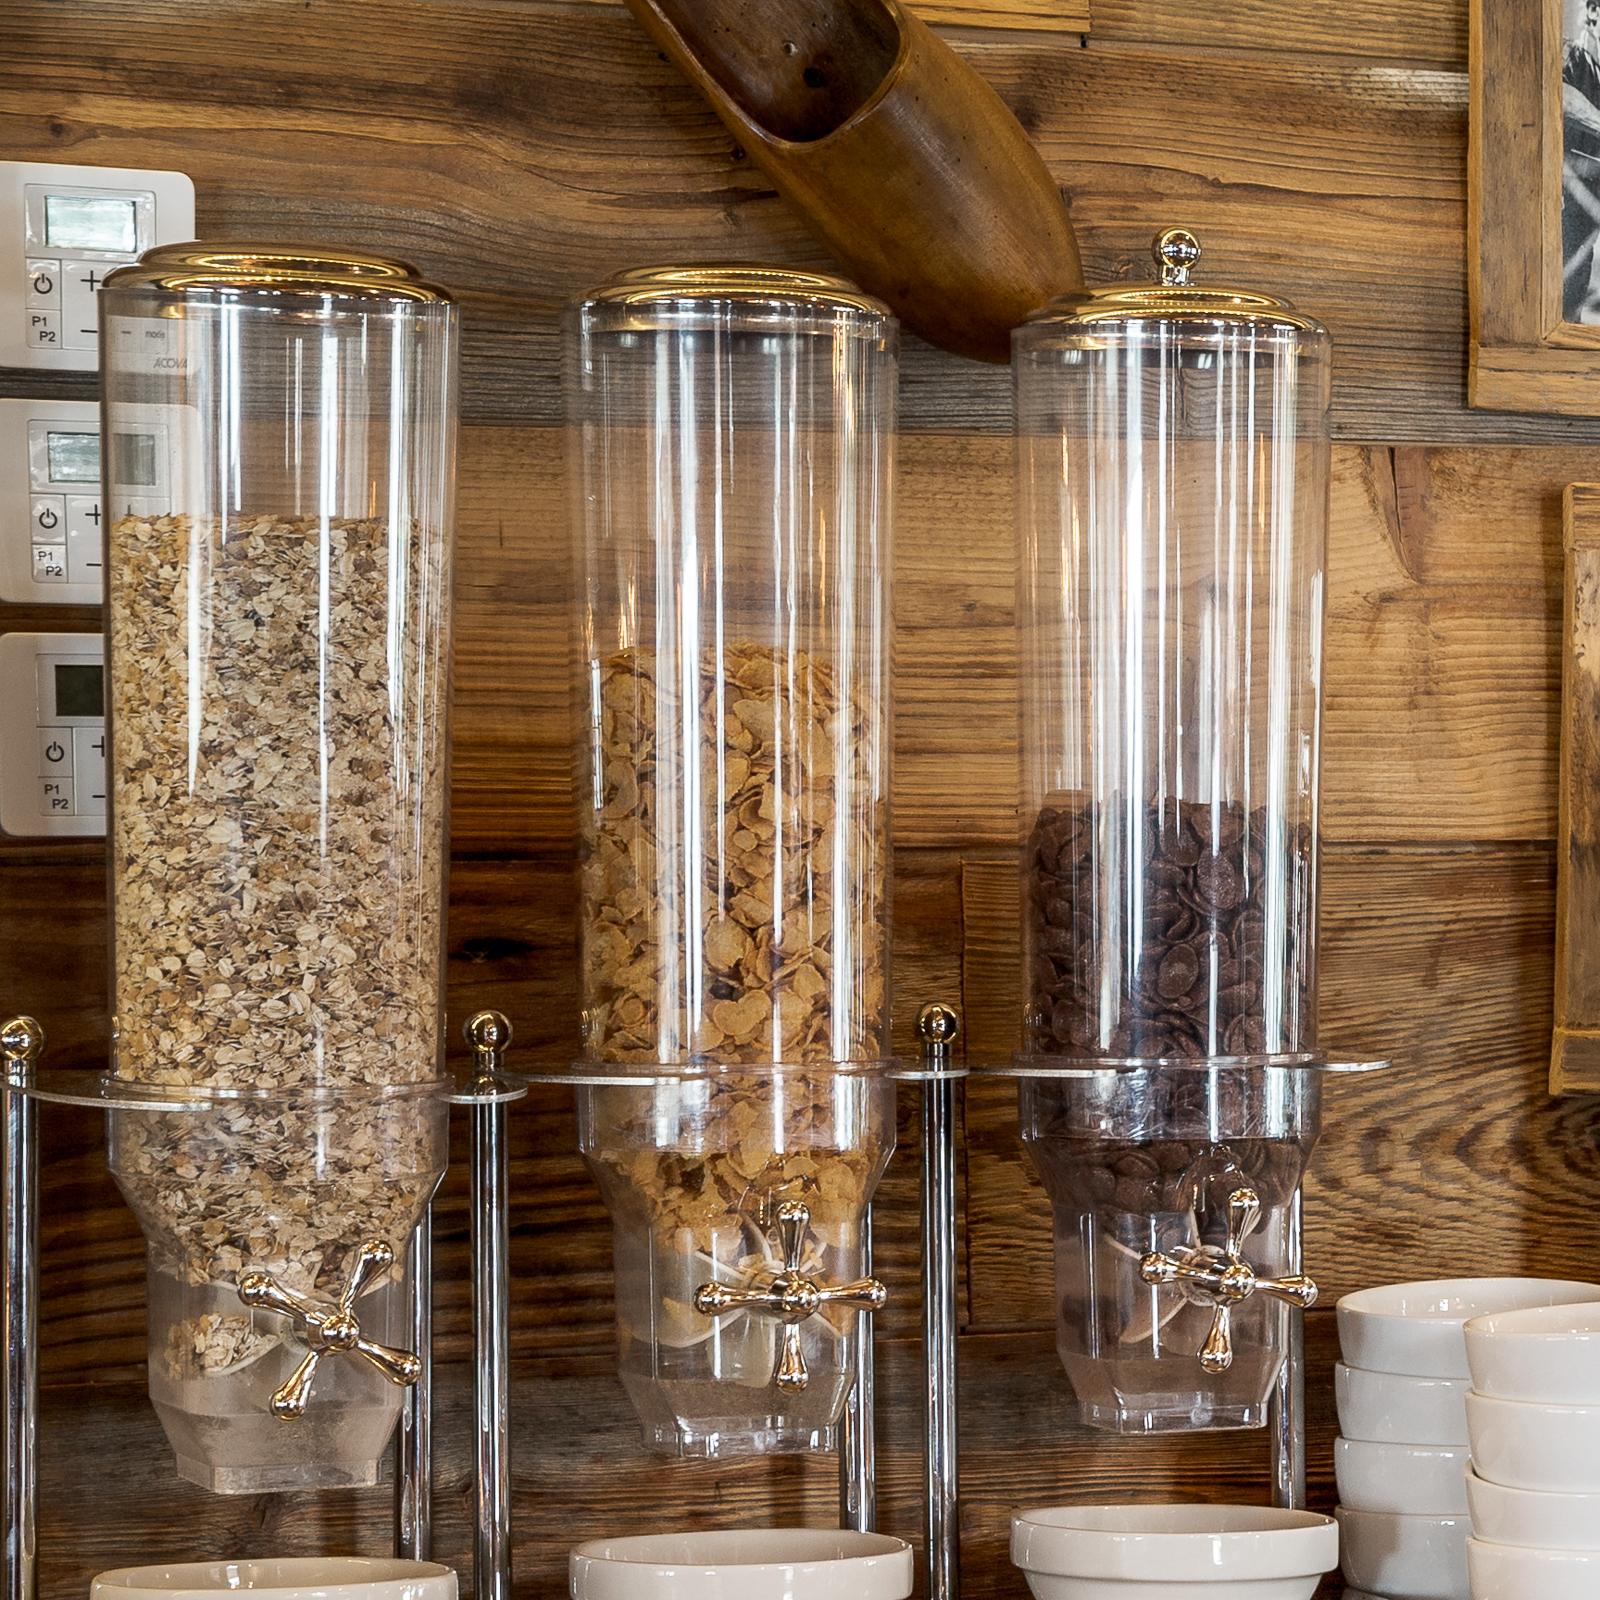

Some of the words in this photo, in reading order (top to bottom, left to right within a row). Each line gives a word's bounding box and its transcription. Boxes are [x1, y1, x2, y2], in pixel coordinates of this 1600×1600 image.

[32, 315, 48, 327] P1
[39, 331, 56, 342] P2
[38, 551, 53, 561] P1
[46, 566, 62, 576] P2
[44, 784, 60, 795] P1
[52, 798, 69, 810] P2
